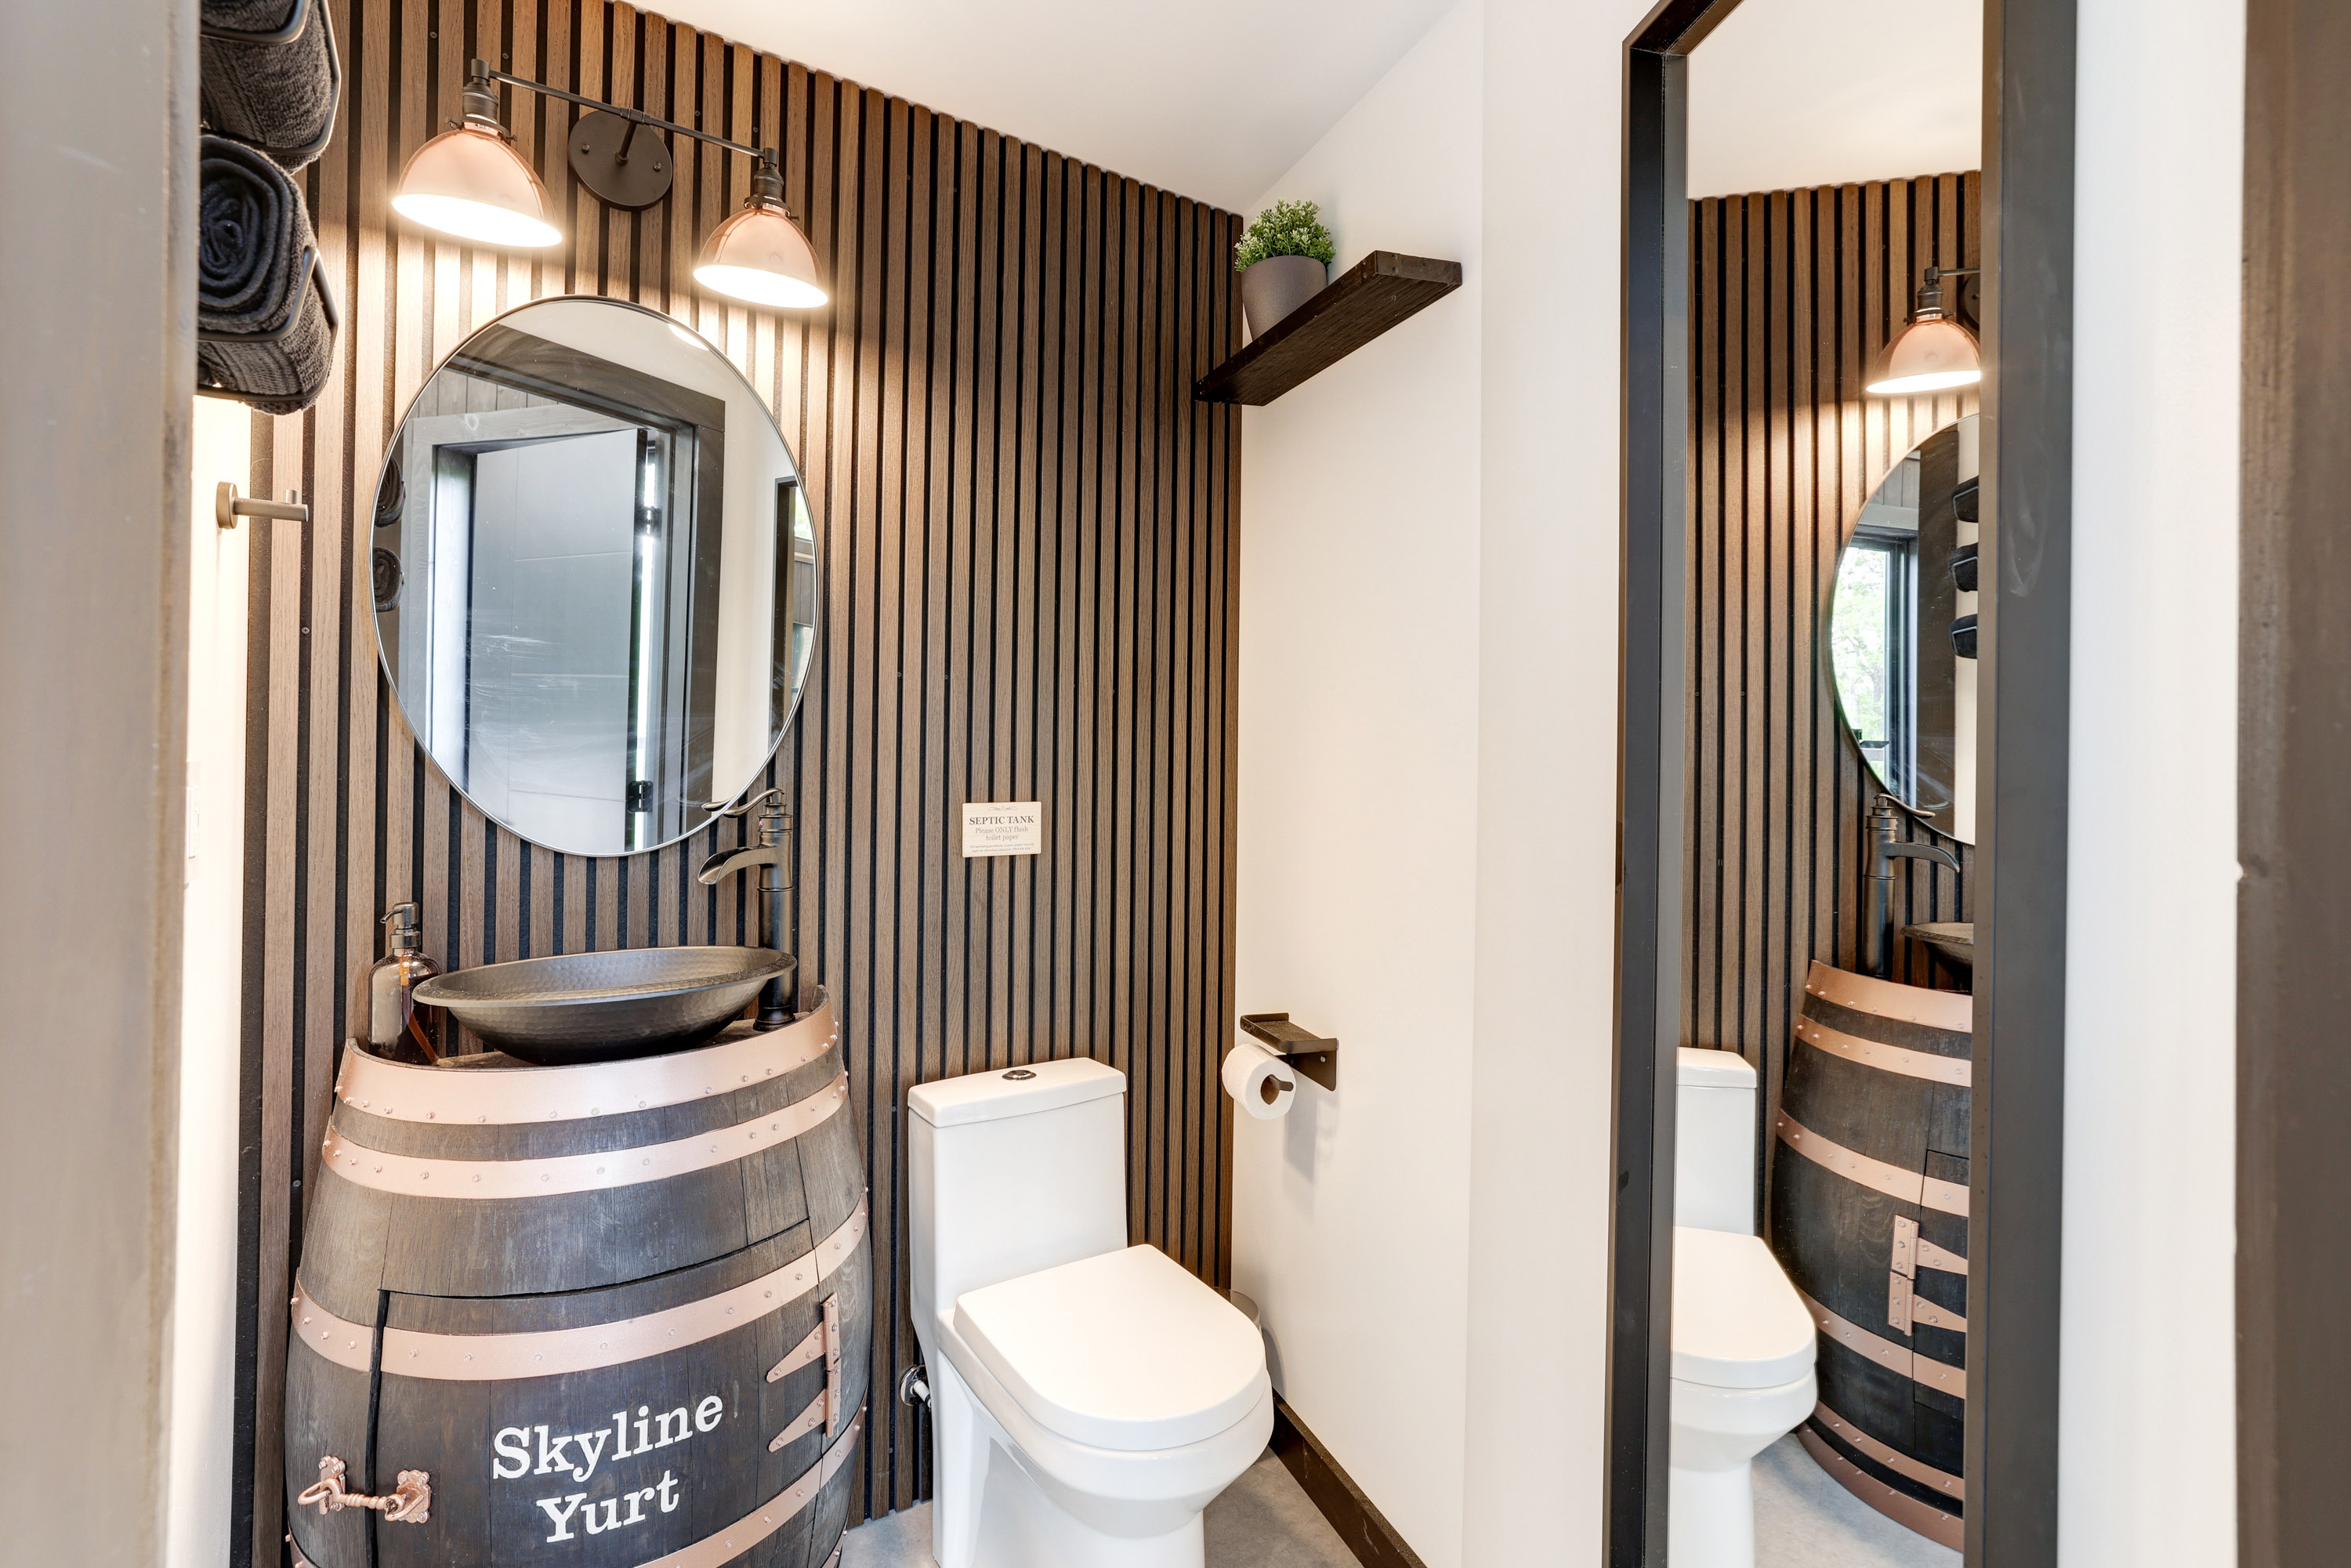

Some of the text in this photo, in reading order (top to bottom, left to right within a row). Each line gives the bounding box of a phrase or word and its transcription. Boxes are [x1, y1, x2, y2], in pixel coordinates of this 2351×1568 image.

[969, 817, 1005, 825] SEPTIC
[493, 1395, 723, 1482] Skyline
[536, 1469, 679, 1543] Yurt
